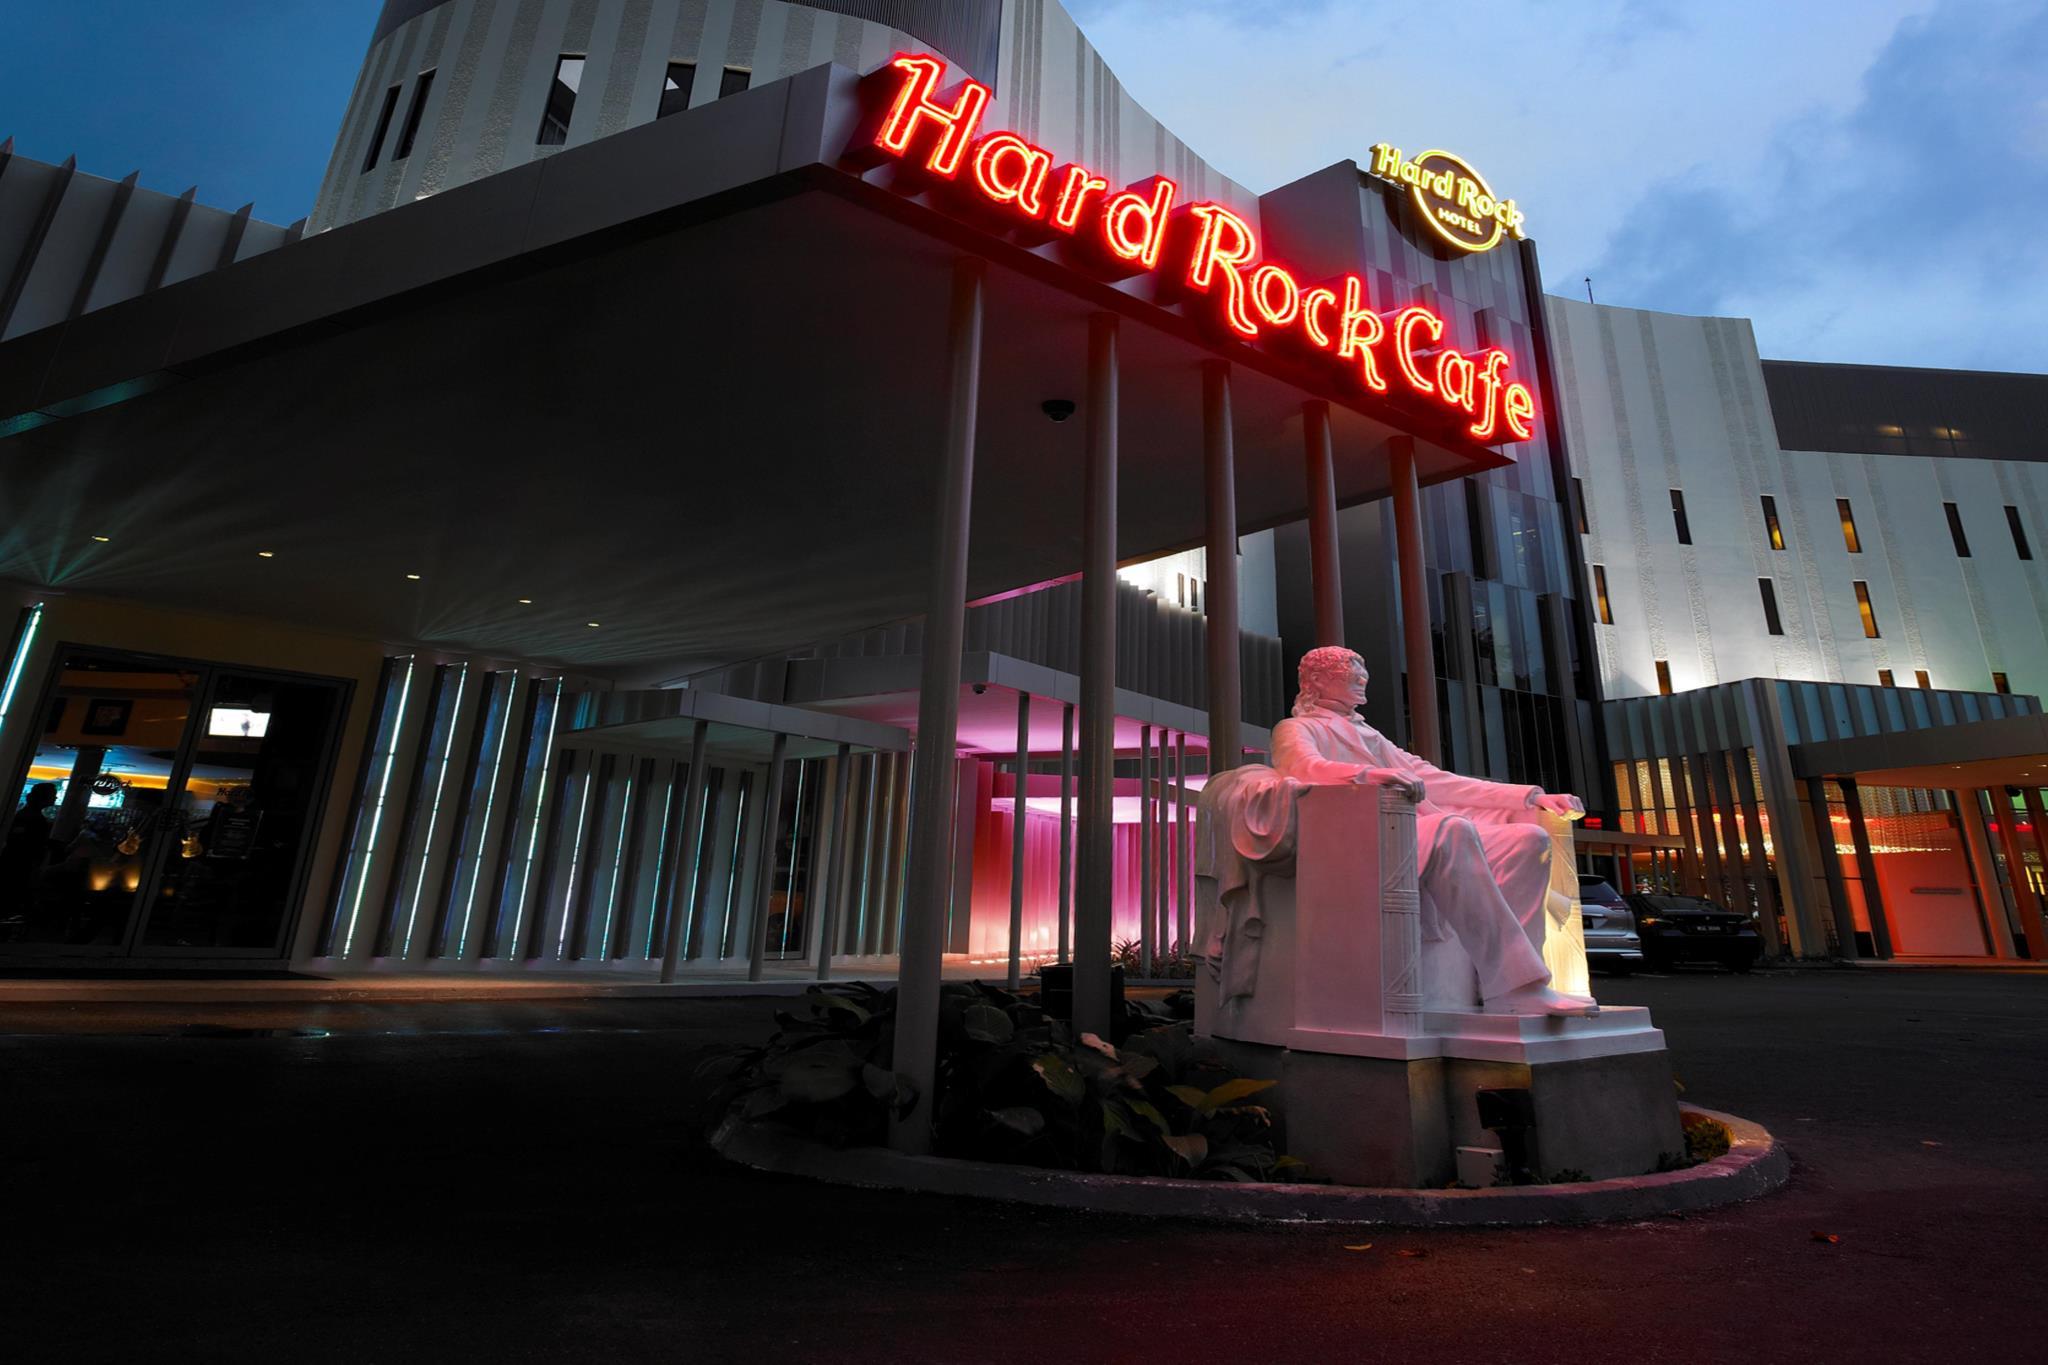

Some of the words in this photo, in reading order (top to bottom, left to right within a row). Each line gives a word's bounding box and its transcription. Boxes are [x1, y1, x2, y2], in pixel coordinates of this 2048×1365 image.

[1377, 143, 1454, 199] Hard
[1457, 176, 1525, 239] Rock
[1437, 207, 1483, 236] HOTEL
[877, 52, 1177, 268] Hard
[1188, 202, 1387, 391] Rock
[1396, 306, 1536, 439] Cafe
